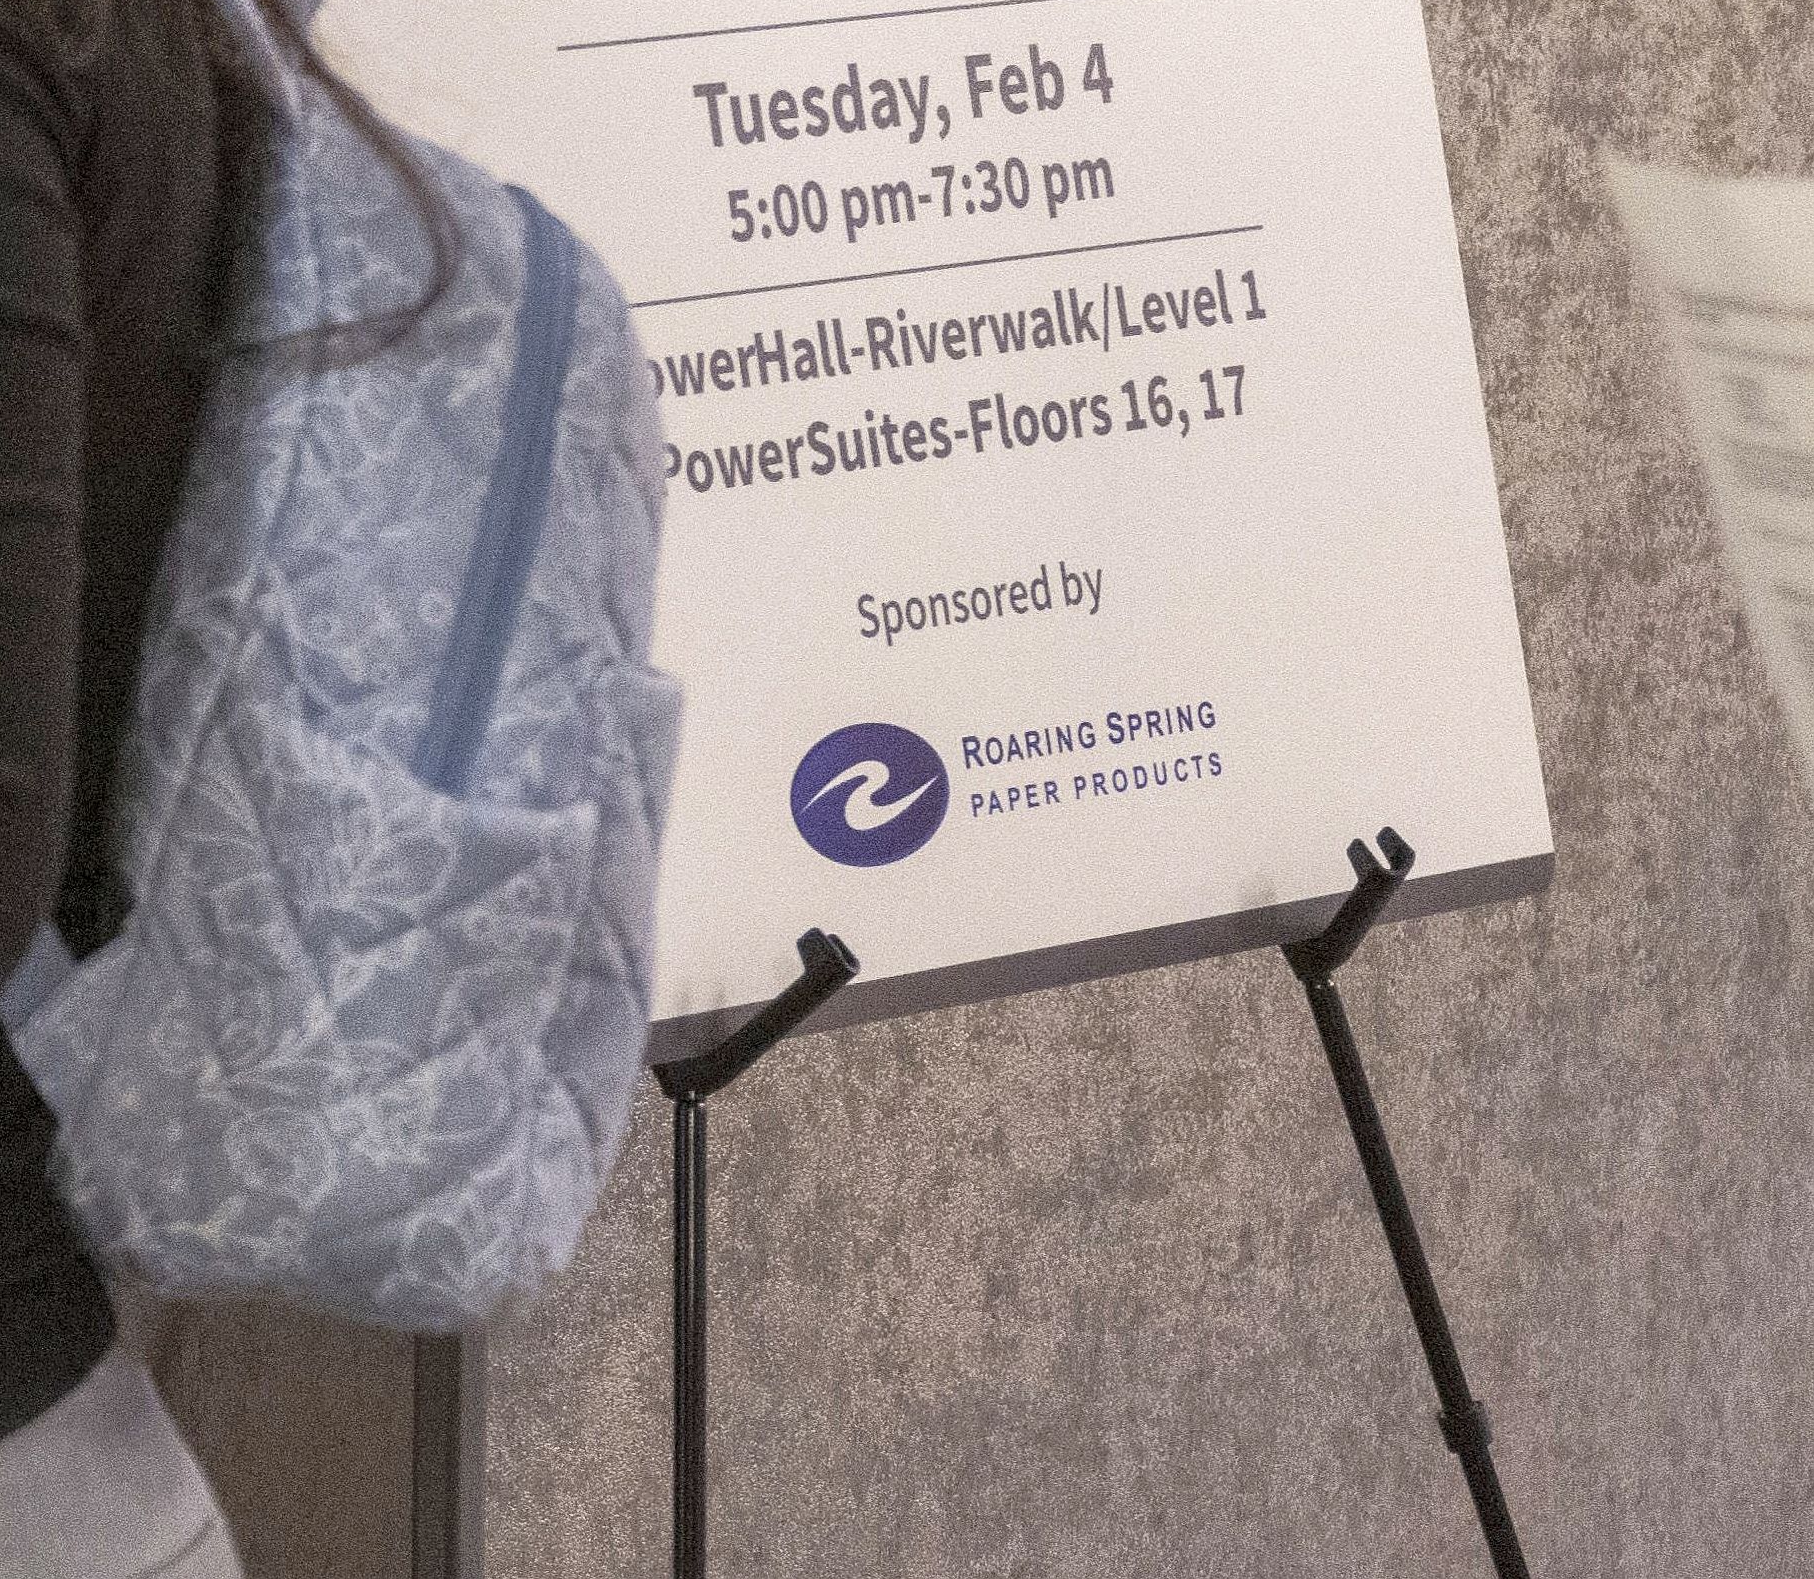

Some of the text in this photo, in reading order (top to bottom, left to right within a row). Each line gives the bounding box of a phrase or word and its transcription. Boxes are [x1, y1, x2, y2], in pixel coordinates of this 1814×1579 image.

[693, 43, 1114, 148] Tuesday, Feb 4
[727, 155, 1116, 244] 5:00 pm-7:30 pm
[1240, 270, 1266, 321] 1
[1119, 374, 1192, 435] 16,
[1201, 365, 1248, 420] 17
[857, 559, 1105, 646] Sponsored by
[969, 752, 1223, 818] PAPER PRODUCTS
